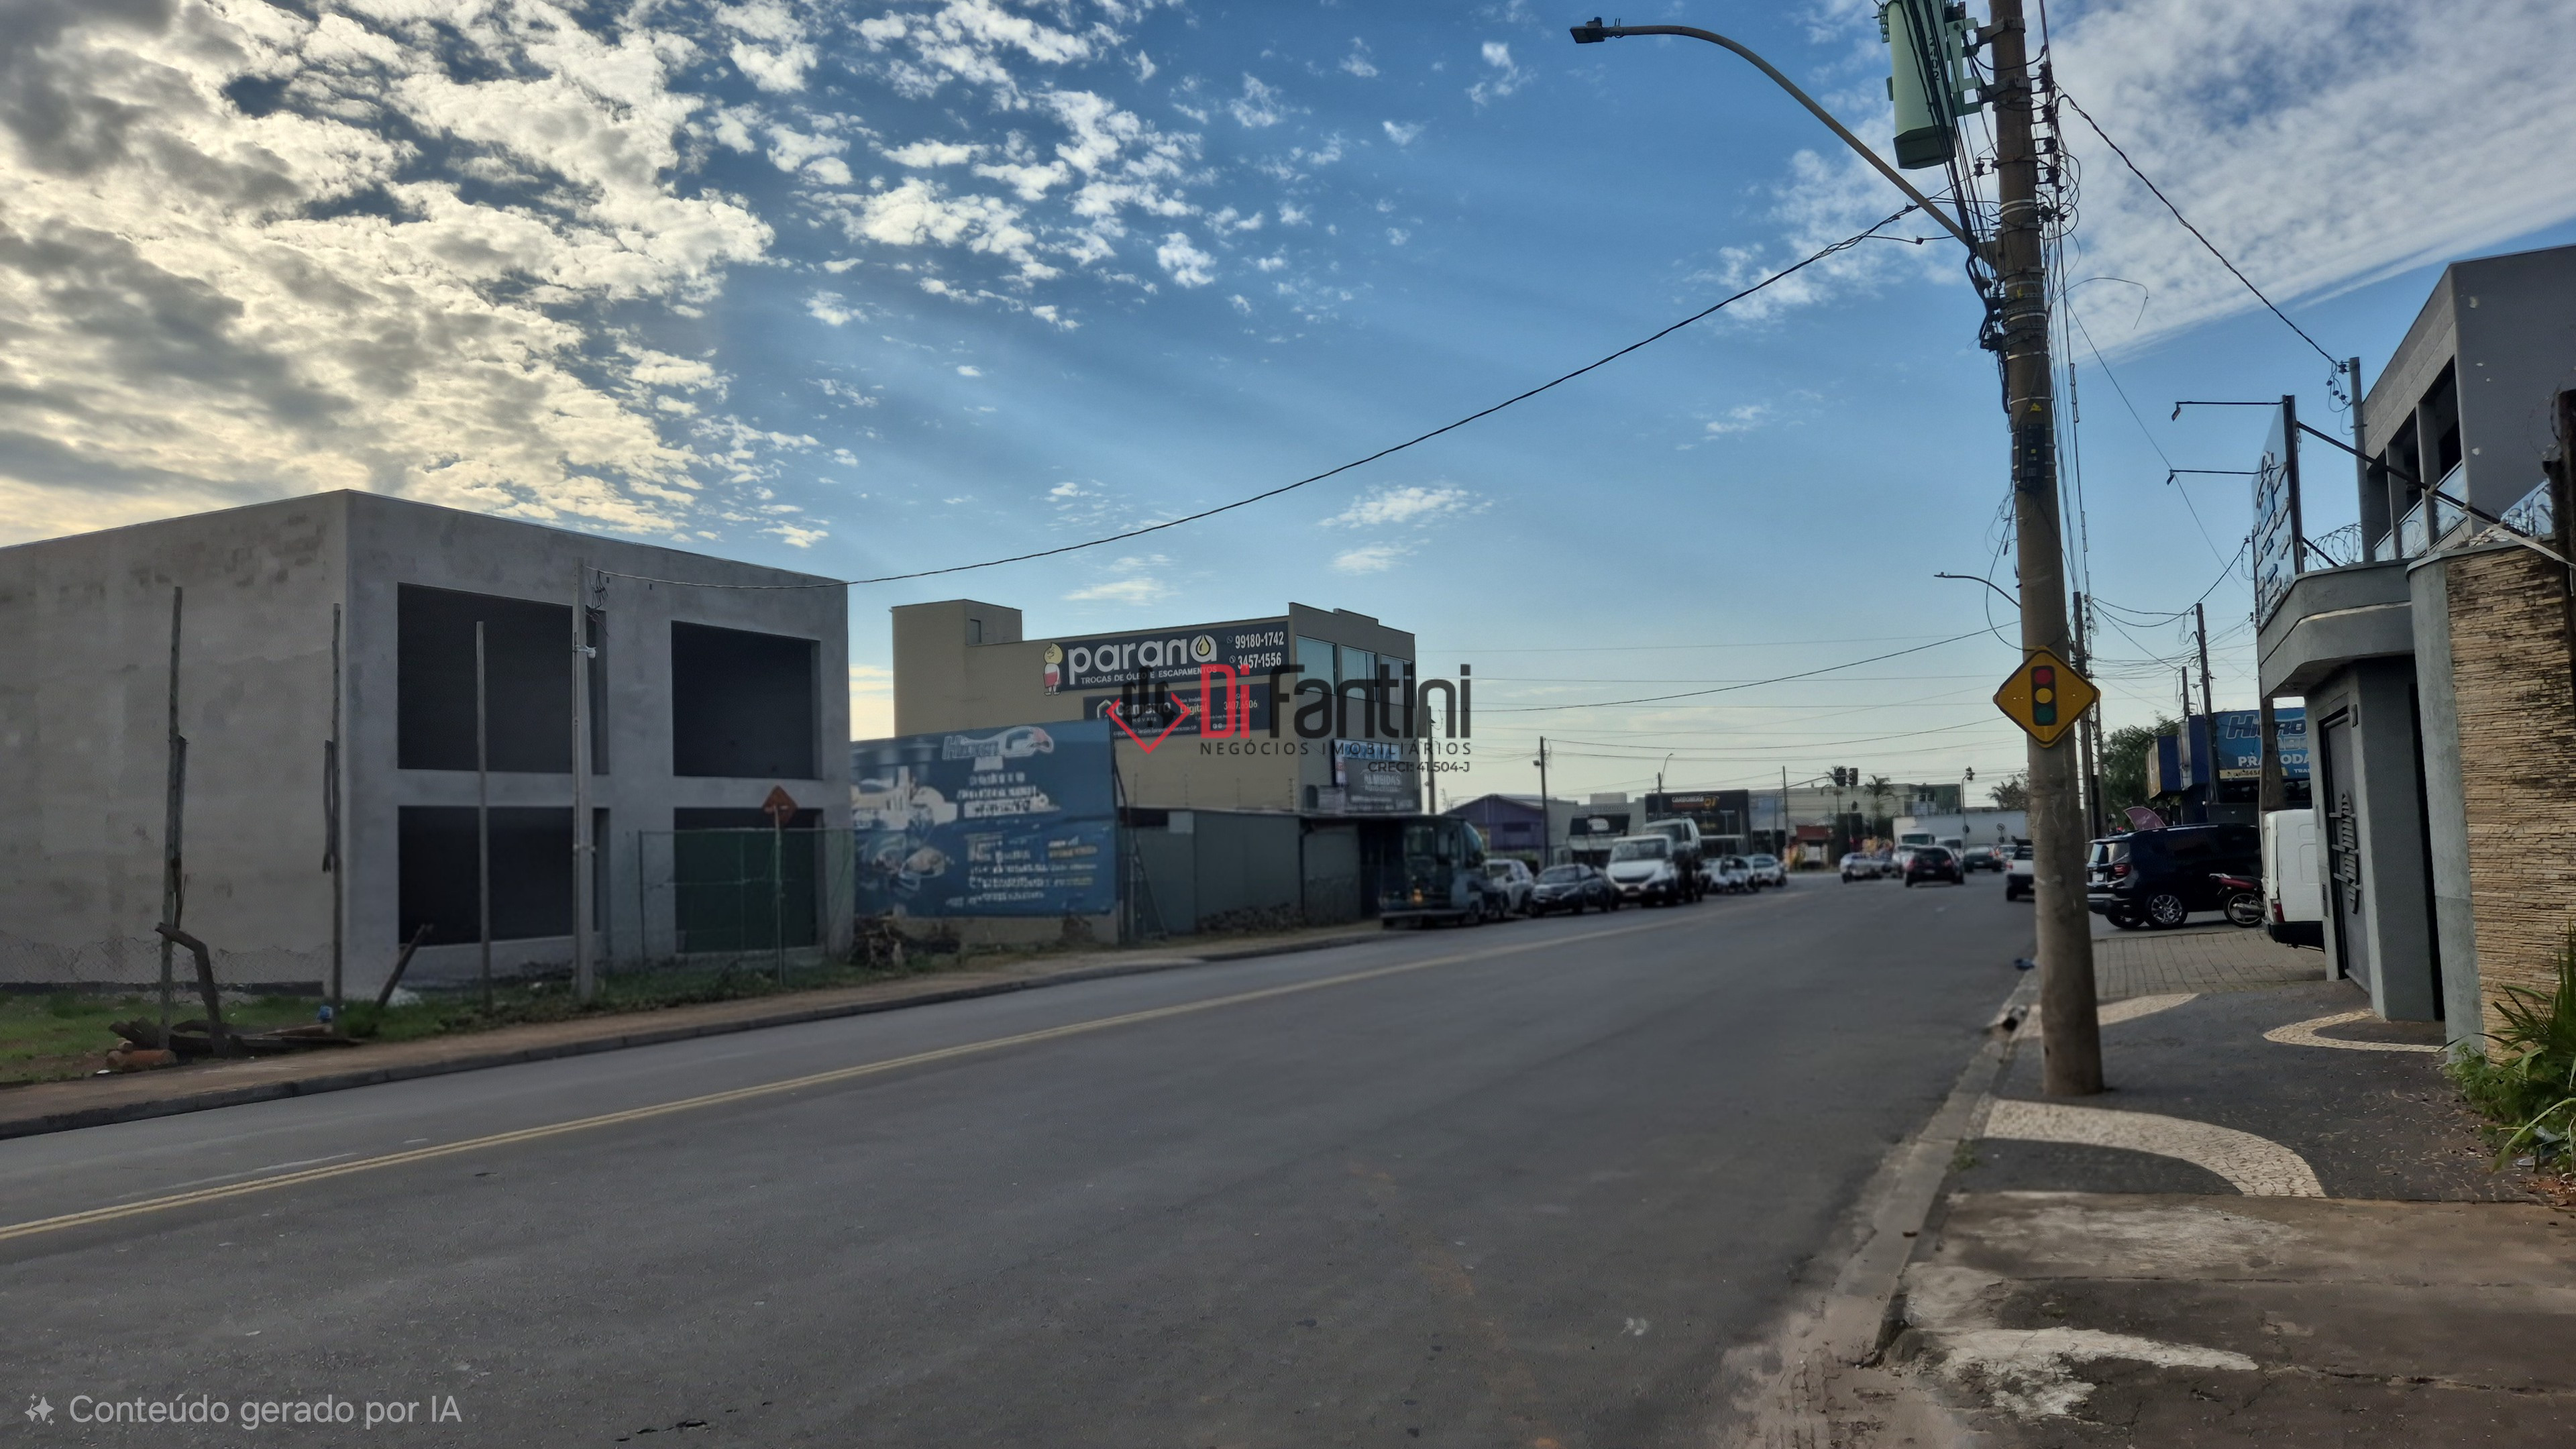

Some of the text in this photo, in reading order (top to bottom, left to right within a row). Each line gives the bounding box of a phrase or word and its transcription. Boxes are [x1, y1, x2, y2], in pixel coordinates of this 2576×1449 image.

[1235, 631, 1284, 649] 99180-1742
[1238, 652, 1281, 669] 3457-1556
[1081, 676, 1112, 684] TROCAS
[1126, 672, 1147, 681] ÓLEO
[1159, 665, 1217, 678] ESCAPAMENTOS
